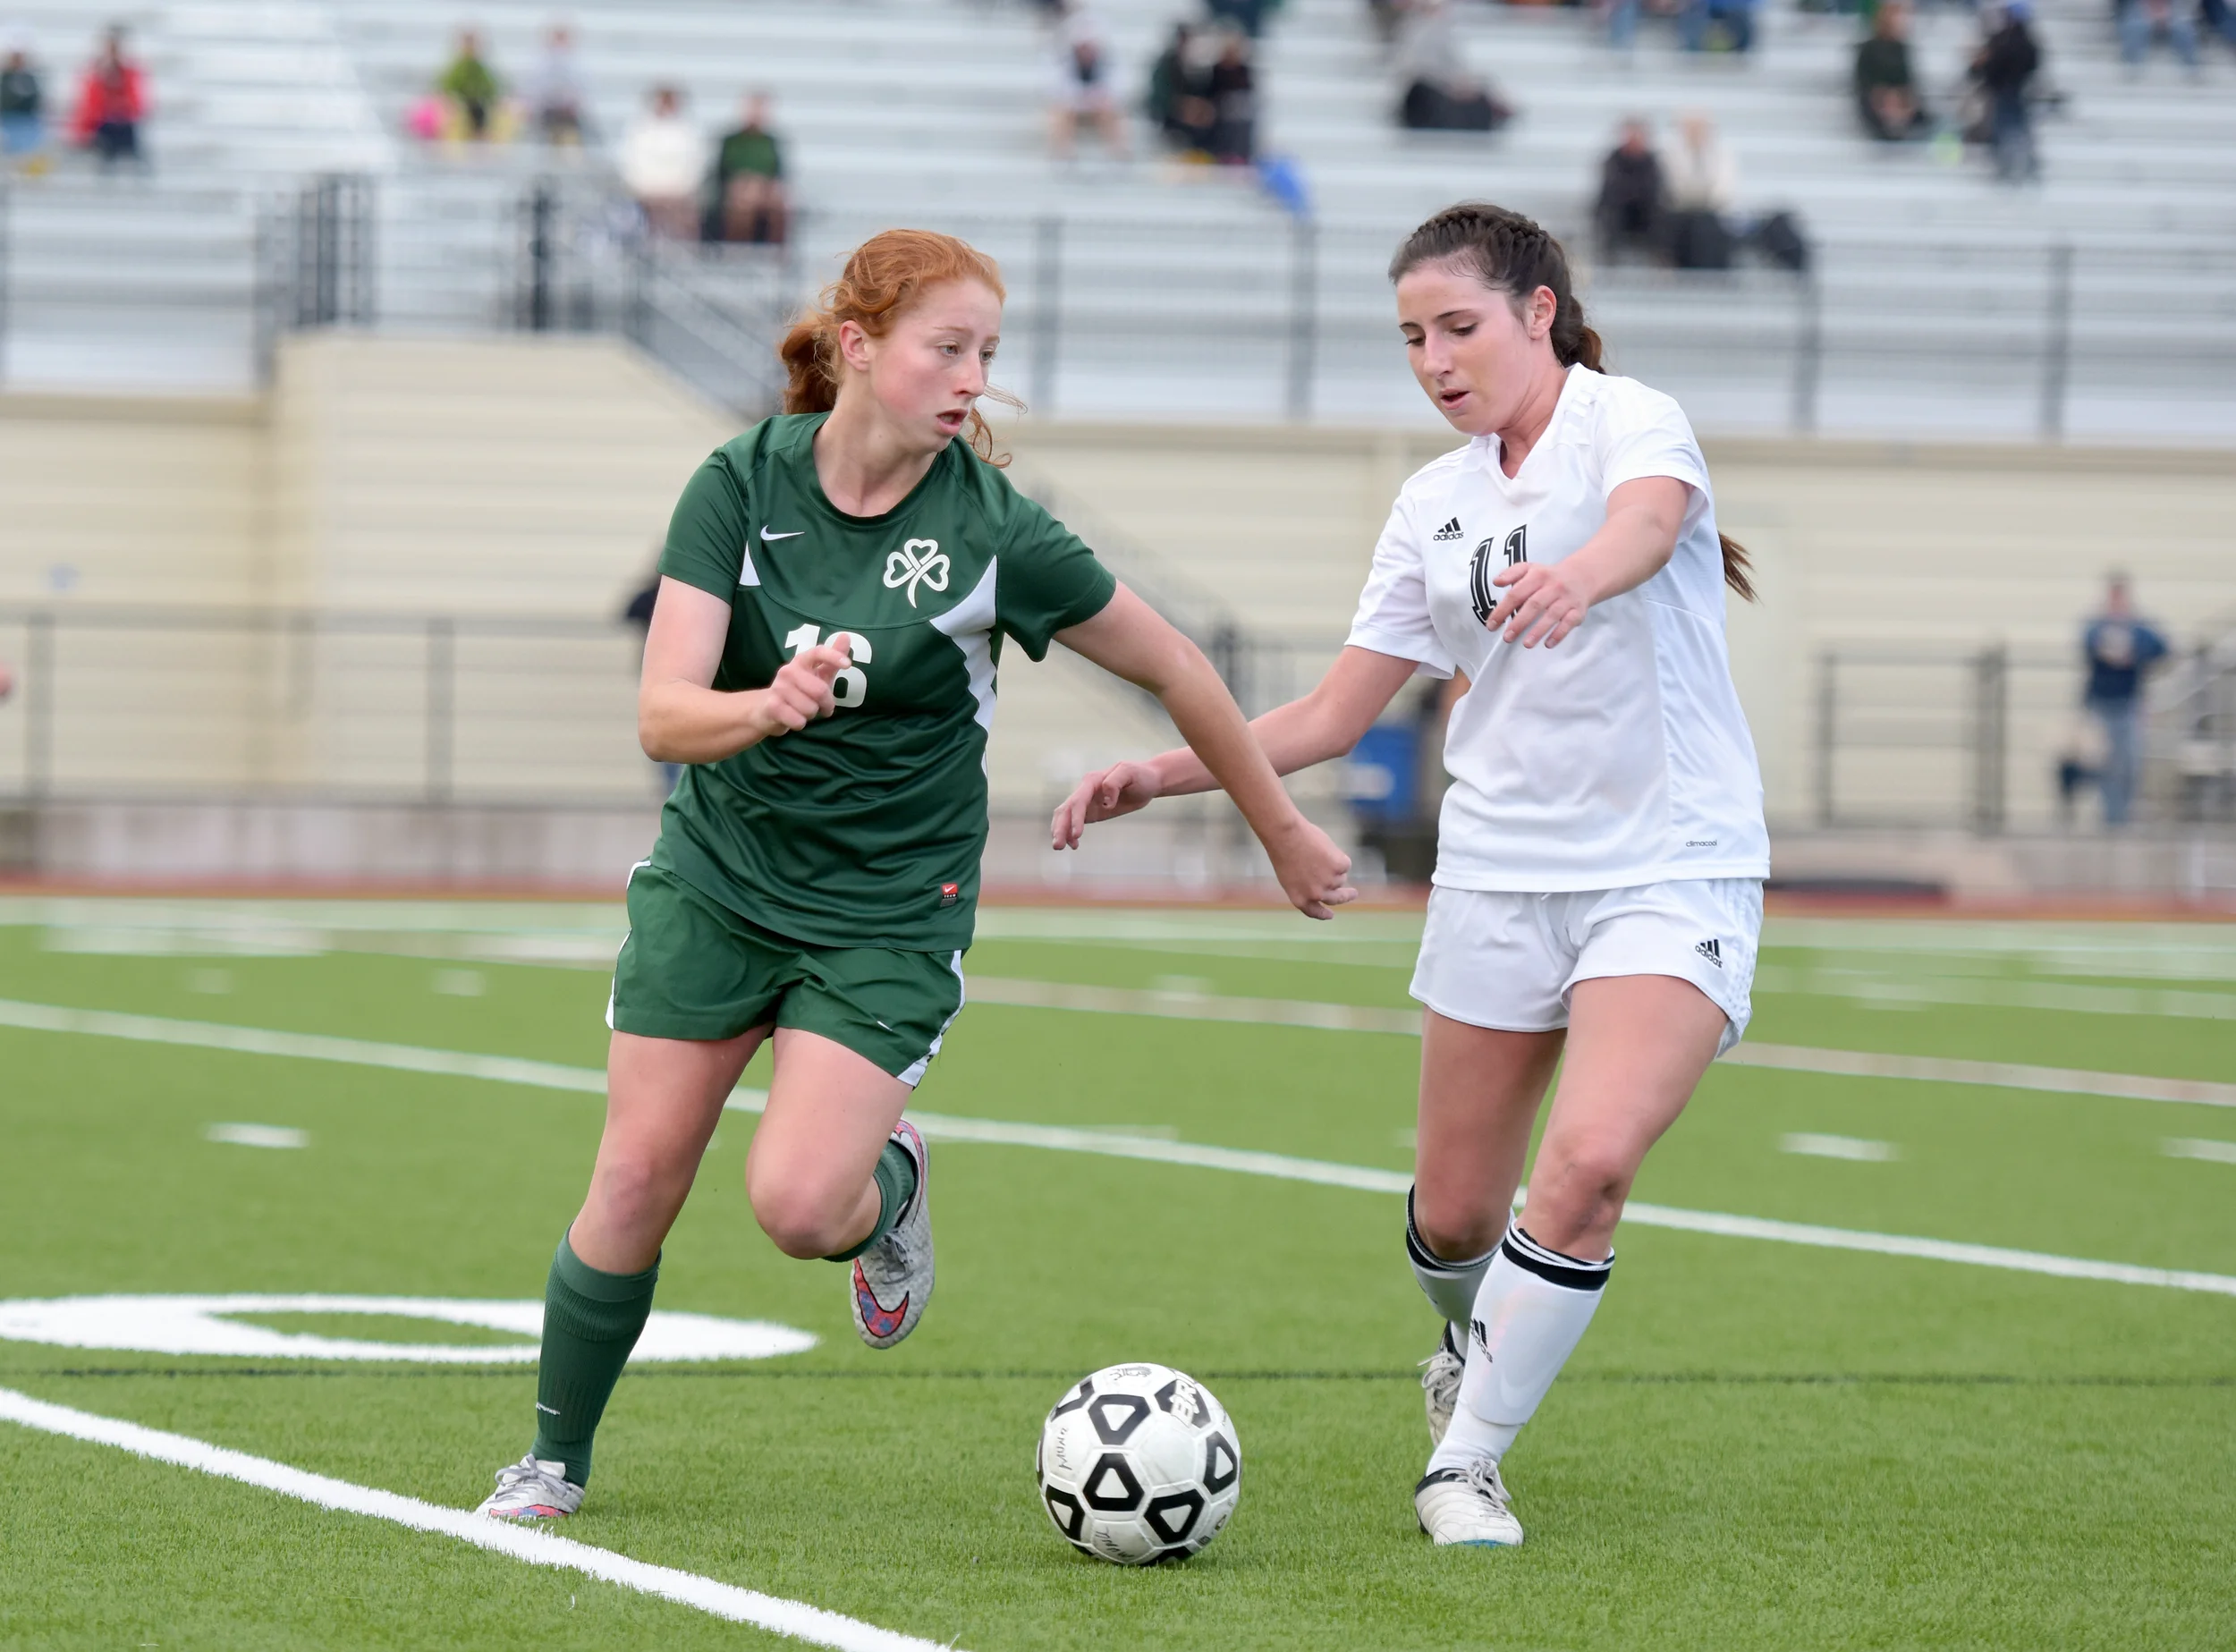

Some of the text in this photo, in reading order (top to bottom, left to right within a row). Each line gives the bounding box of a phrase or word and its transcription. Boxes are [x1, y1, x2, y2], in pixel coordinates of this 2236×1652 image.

[1433, 530, 1464, 541] adidas
[1685, 839, 1718, 848] climacool
[1695, 944, 1723, 969] adidas
